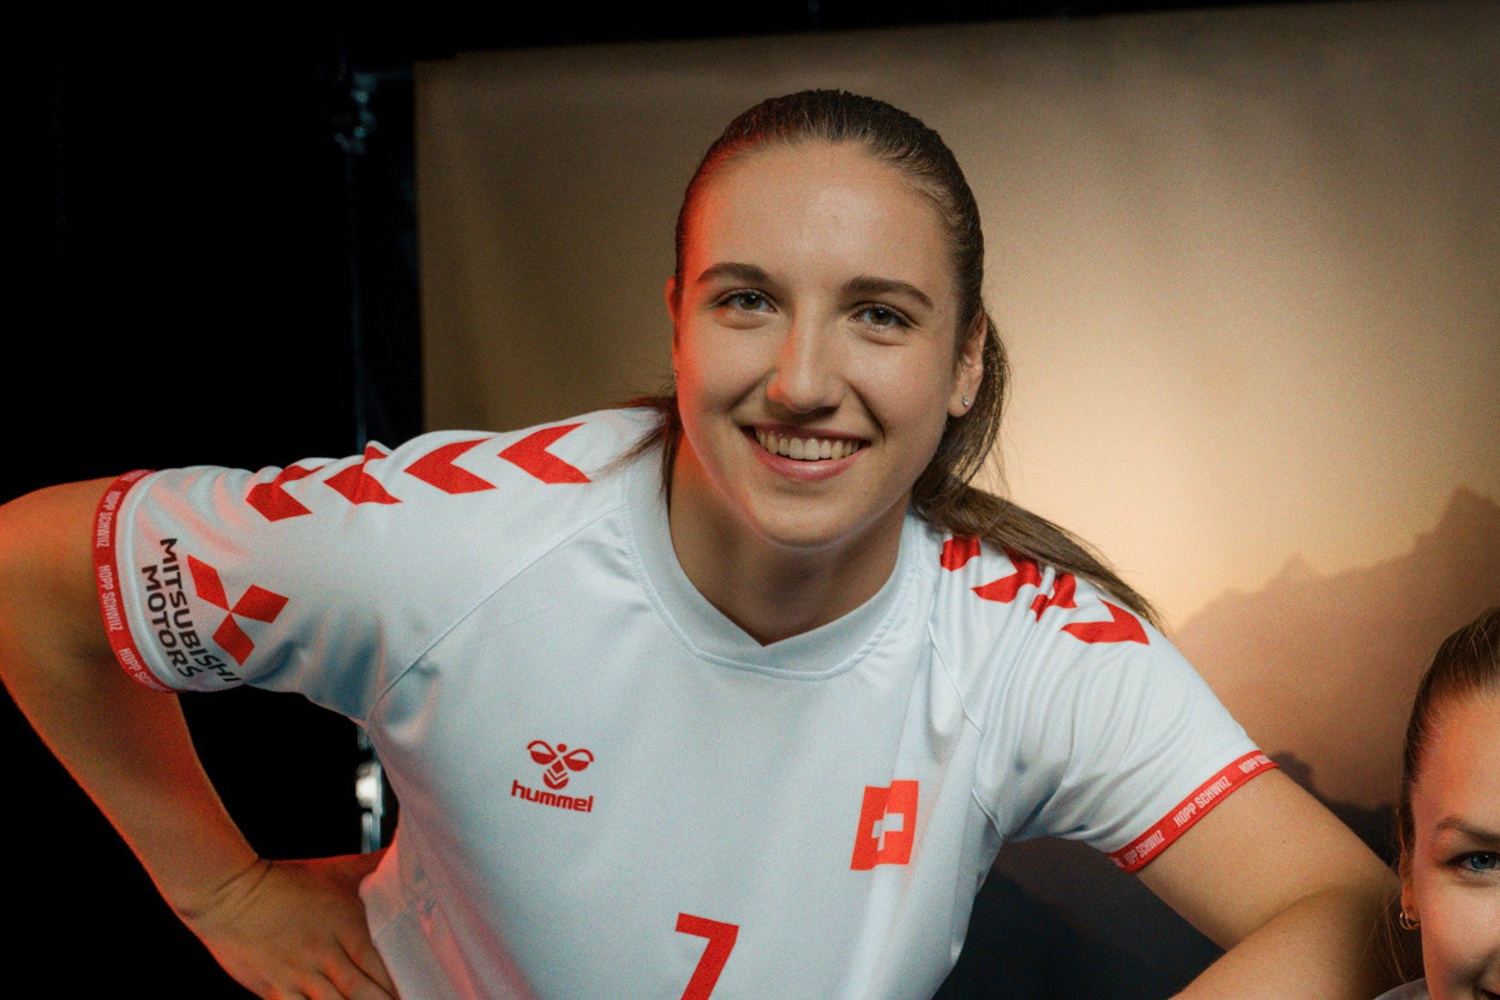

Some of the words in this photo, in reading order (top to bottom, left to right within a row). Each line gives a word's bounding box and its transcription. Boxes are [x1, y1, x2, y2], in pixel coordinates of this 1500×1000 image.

[142, 565, 204, 678] MOTORS
[159, 538, 242, 682] MITSUBISHI
[511, 780, 594, 813] hummel
